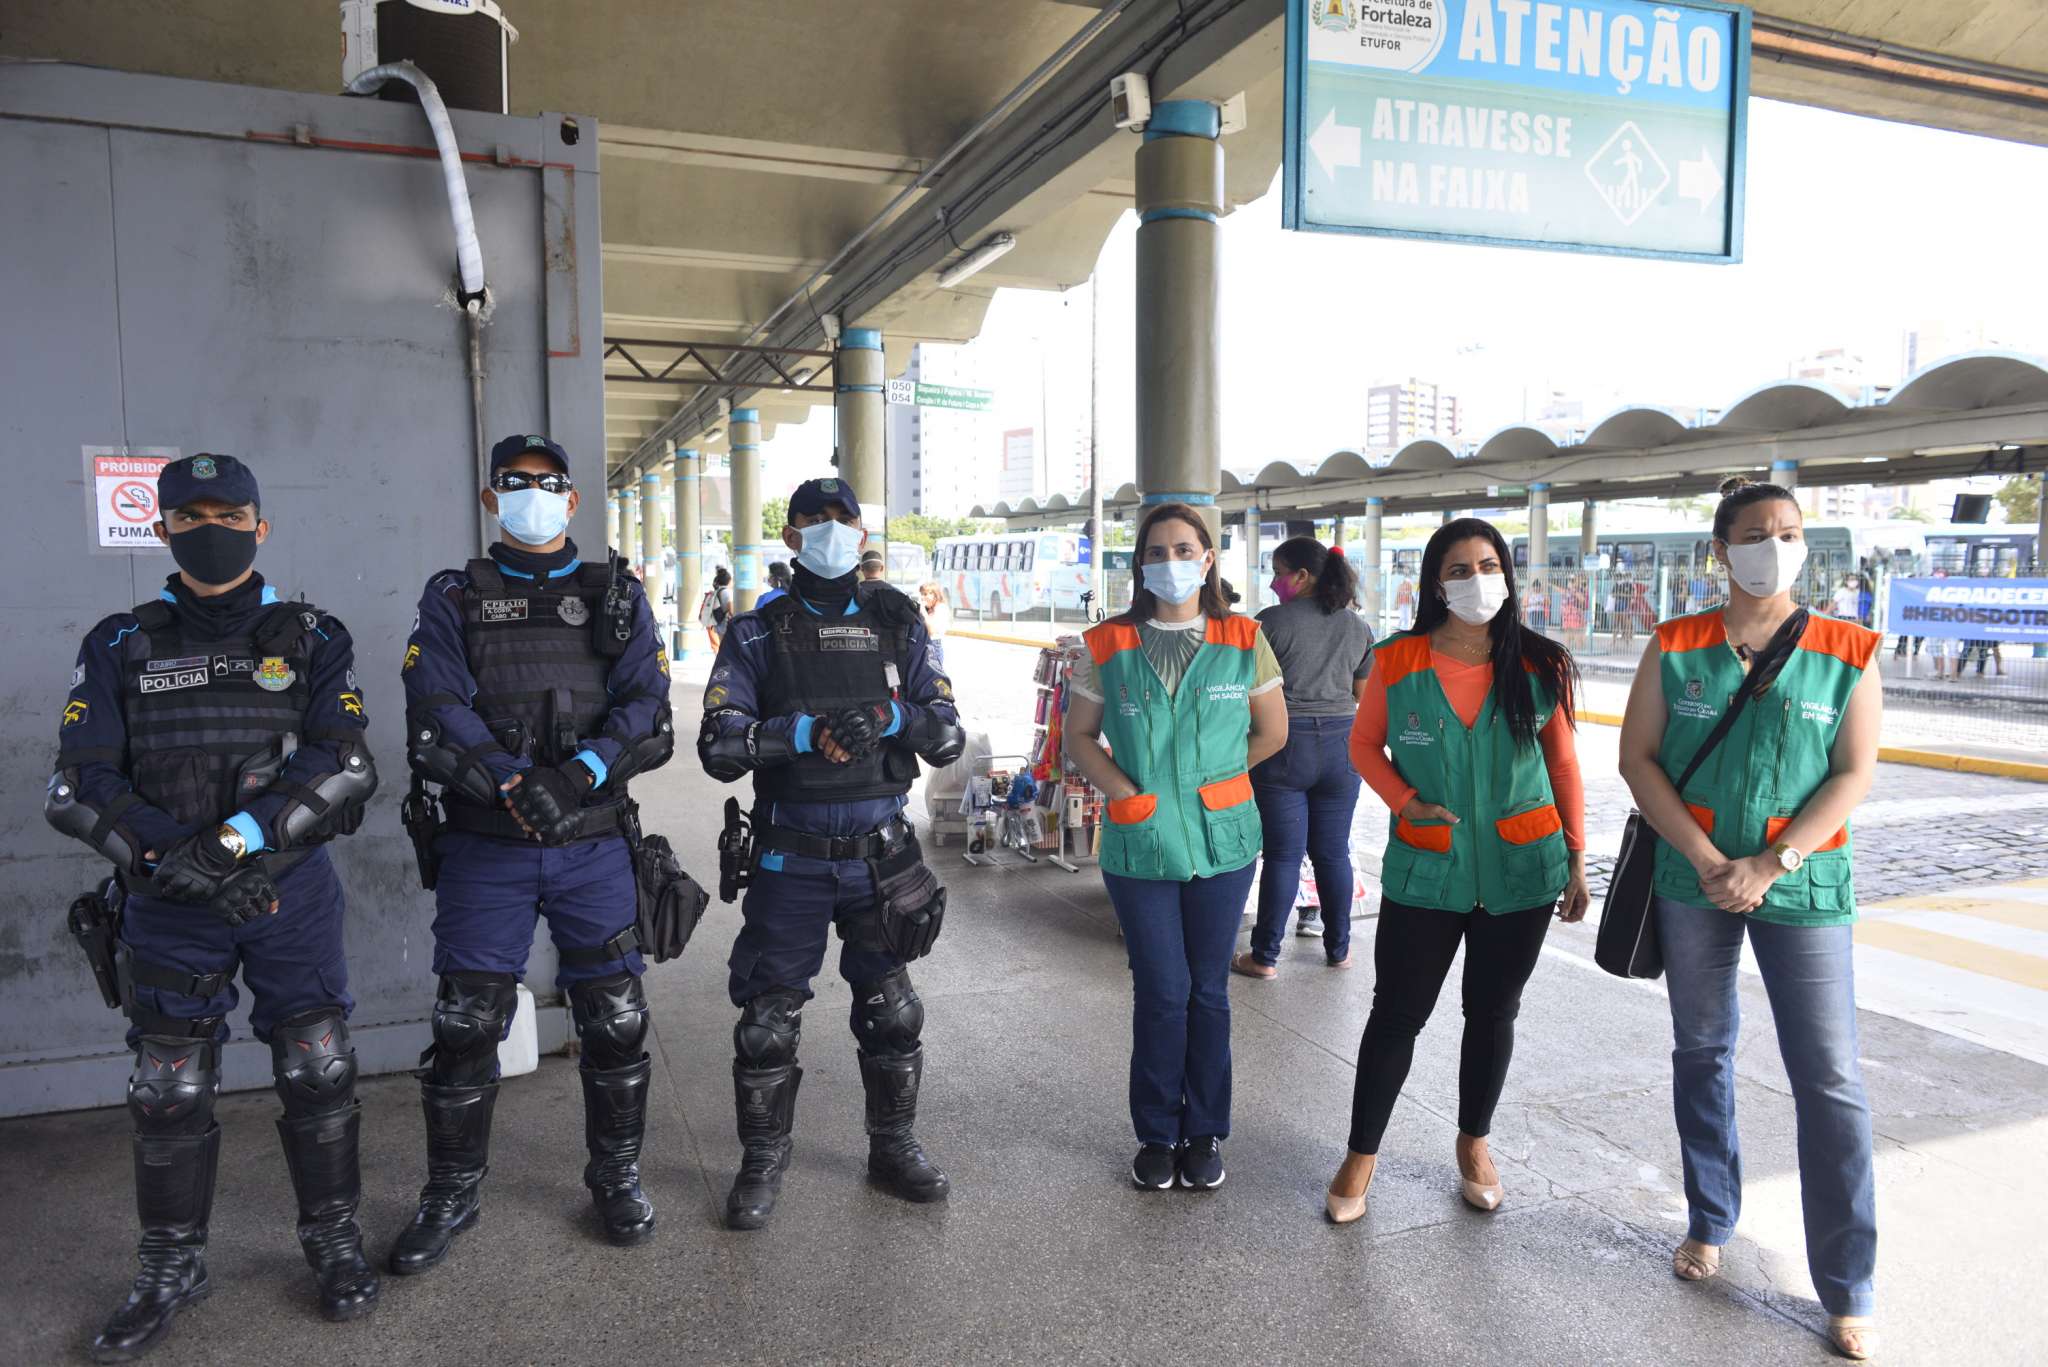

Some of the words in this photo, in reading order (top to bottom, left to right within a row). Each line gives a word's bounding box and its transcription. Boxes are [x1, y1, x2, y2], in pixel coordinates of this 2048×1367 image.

[1419, 0, 1432, 10] de
[1361, 5, 1432, 28] Fortaleza
[1360, 37, 1401, 51] ETUFOR
[1457, 0, 1722, 94] ATENÇÃO
[1372, 97, 1572, 158] ATRAVESSE
[1372, 160, 1420, 206] NA
[1430, 166, 1530, 213] FAIXA
[892, 381, 911, 391] 050
[891, 393, 911, 402] 054
[108, 526, 157, 537] FUMA
[823, 638, 867, 649] POLÍCIA
[143, 672, 205, 690] POLÍCIA
